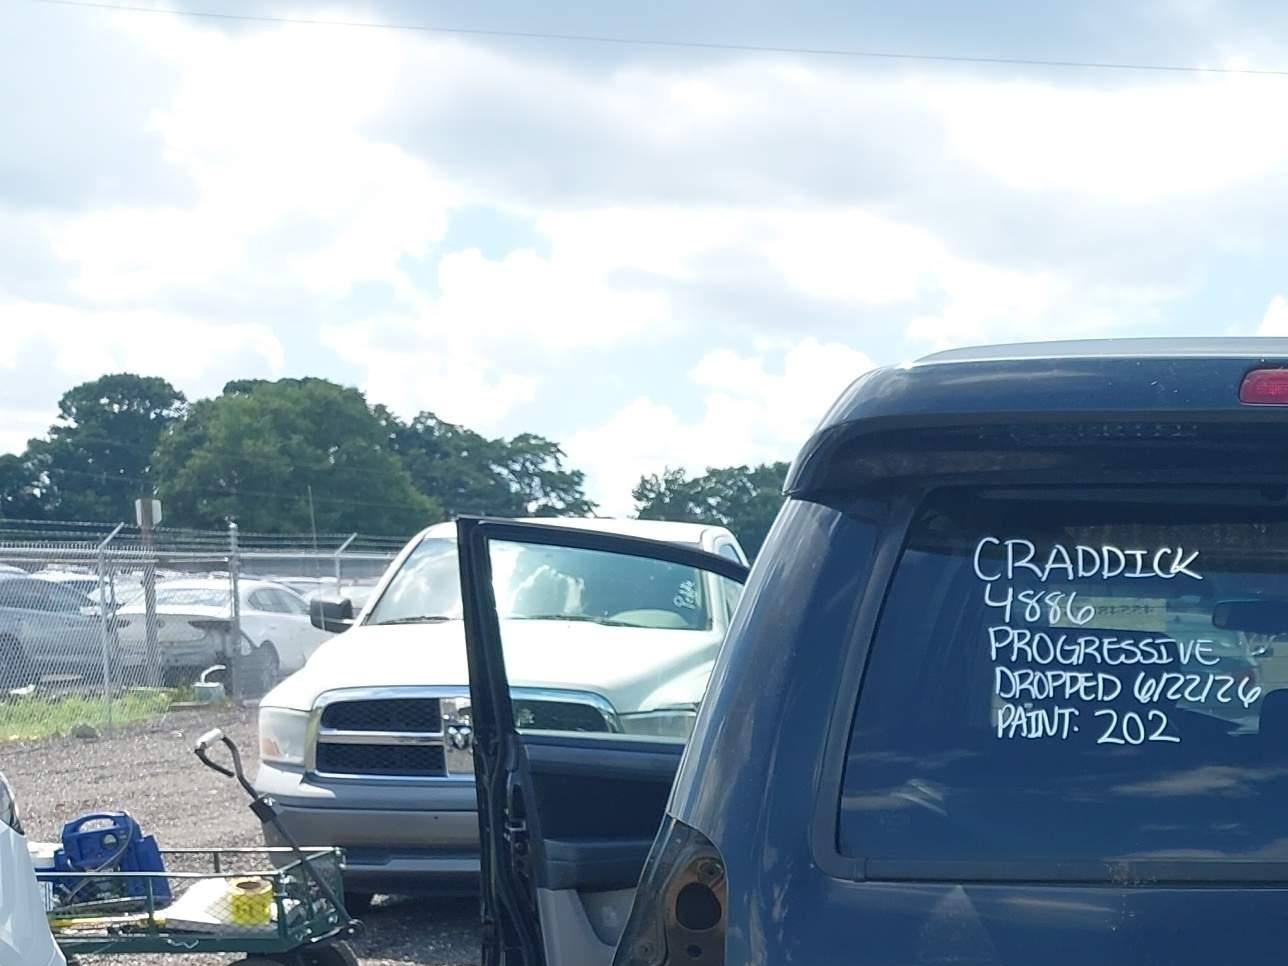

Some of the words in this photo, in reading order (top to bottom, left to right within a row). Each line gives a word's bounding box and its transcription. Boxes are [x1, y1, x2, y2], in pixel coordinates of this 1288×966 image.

[974, 537, 1203, 582] CRADDICK
[984, 583, 1095, 625] 4886
[987, 627, 1220, 666] PROGRESSIVE
[995, 666, 1121, 701] DROPPED
[1134, 671, 1261, 708] 6/22/26
[1094, 710, 1180, 744] 202
